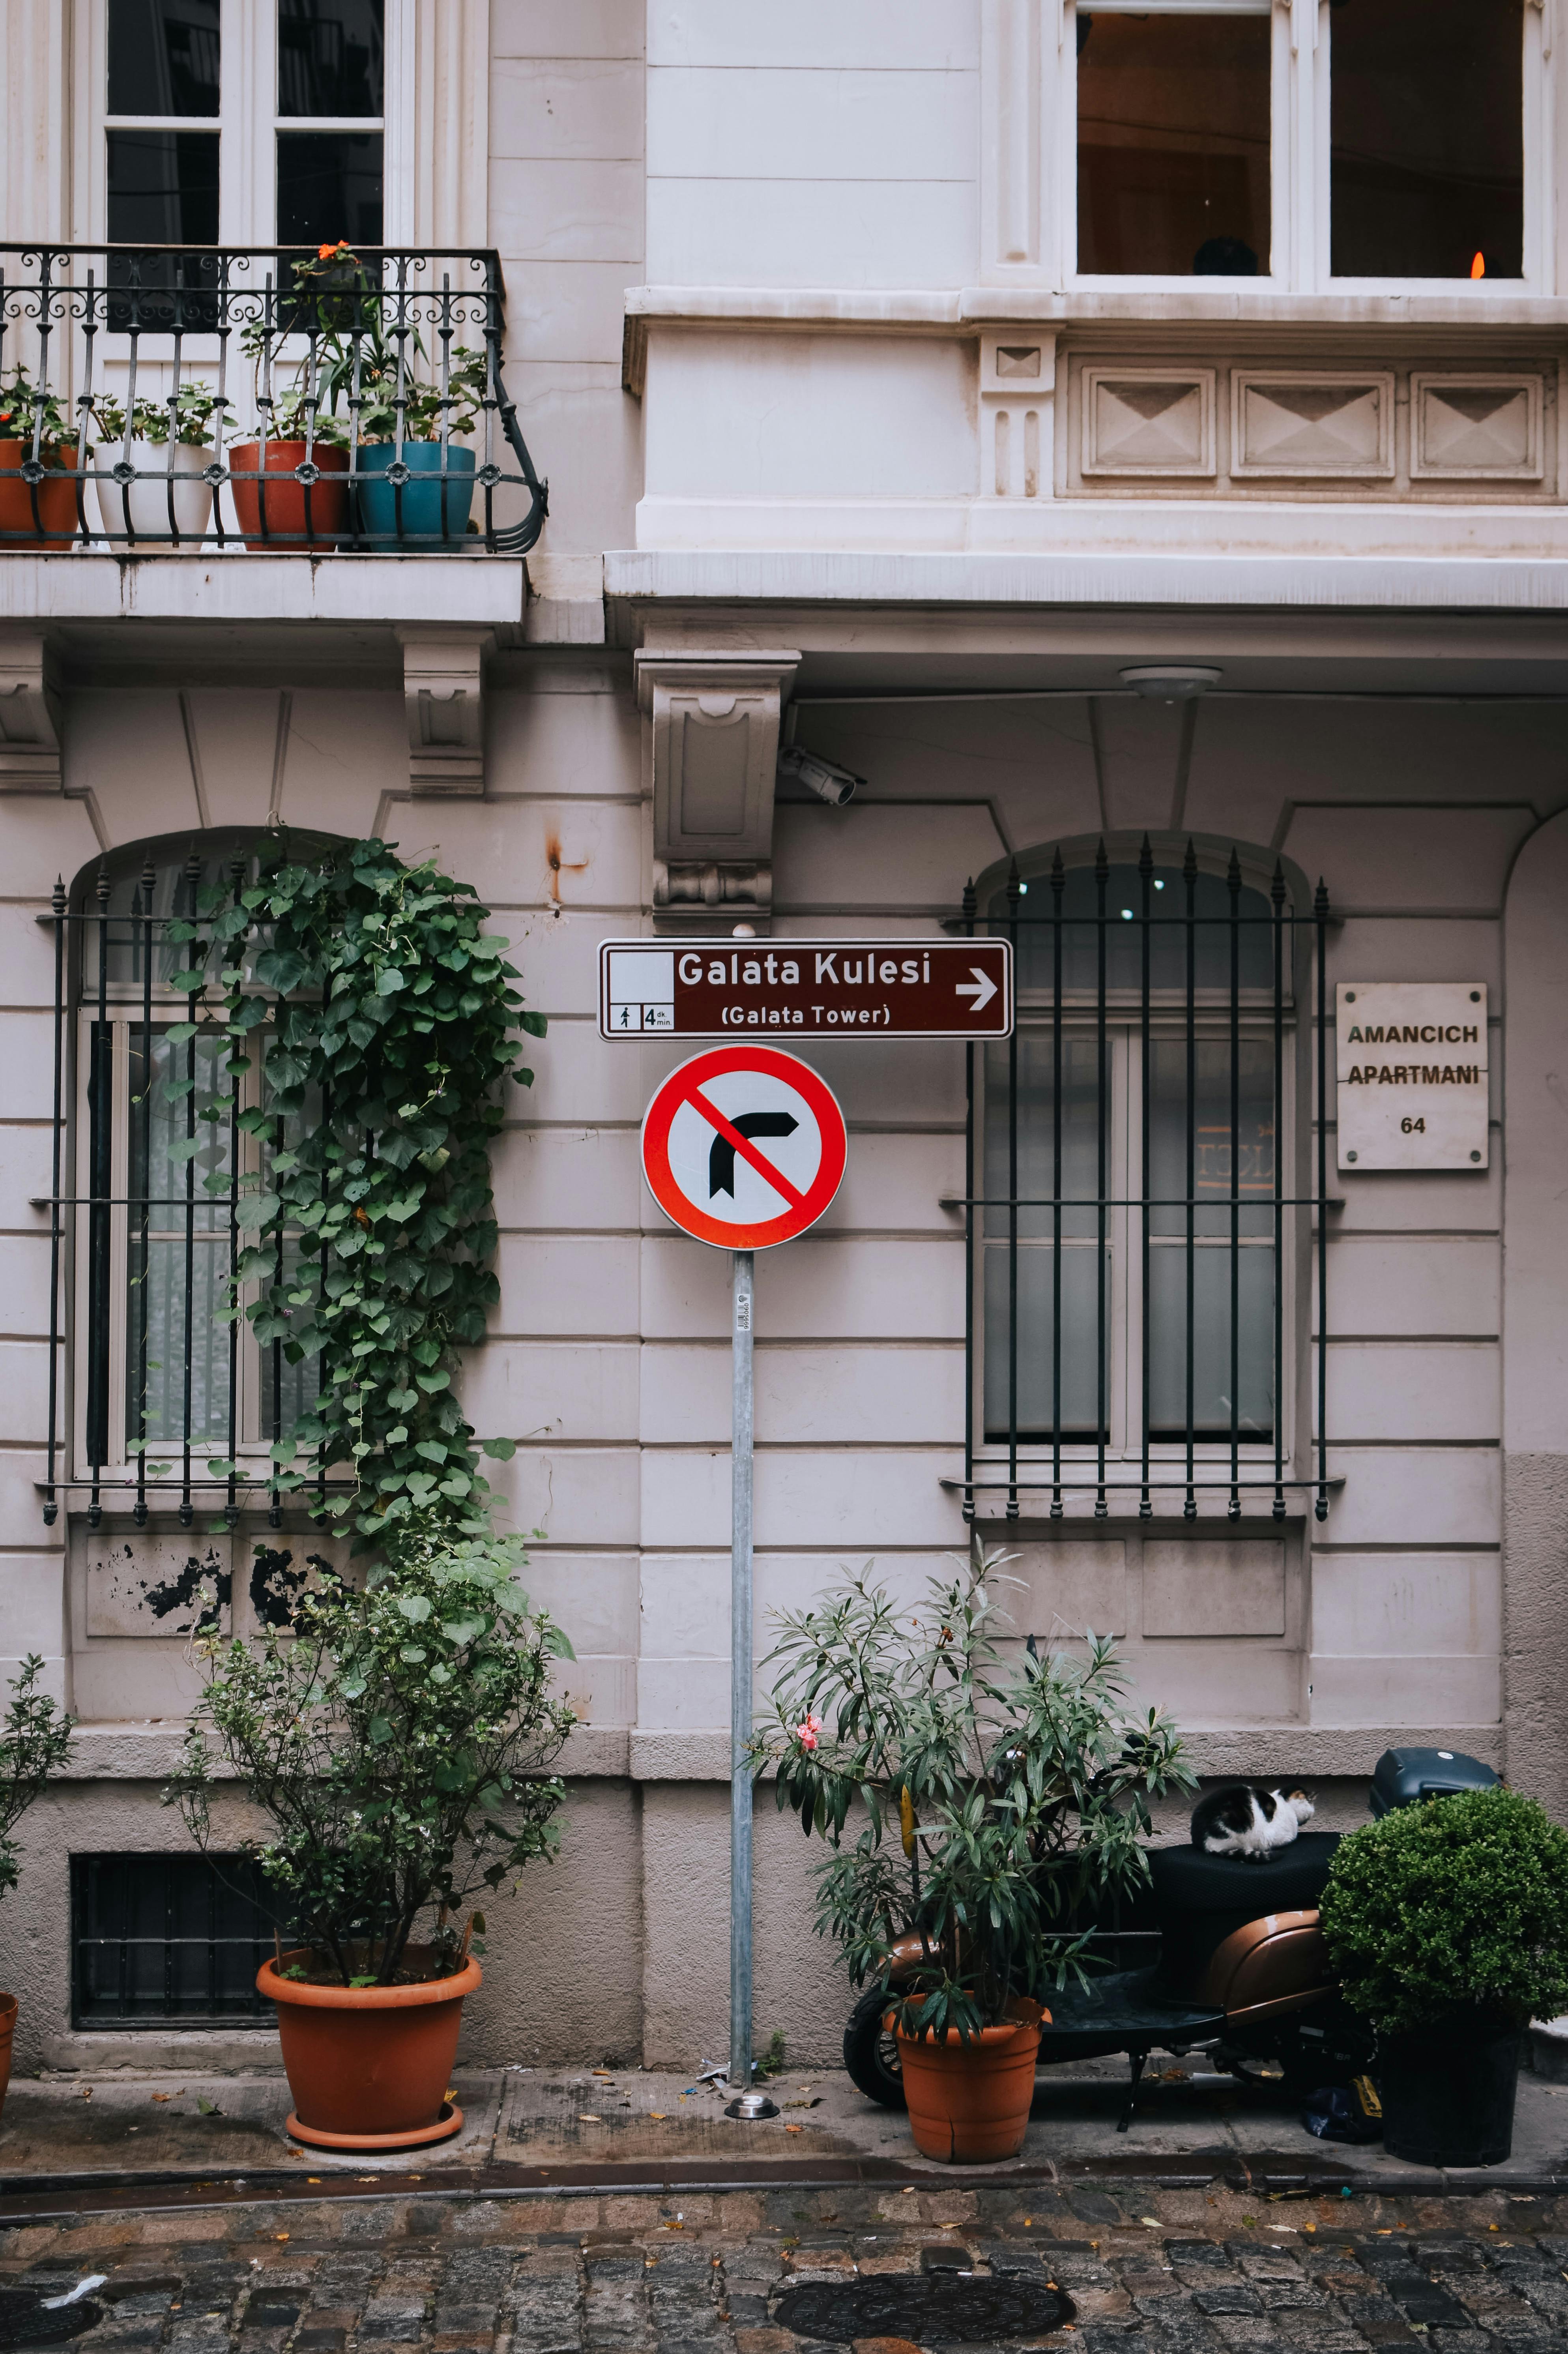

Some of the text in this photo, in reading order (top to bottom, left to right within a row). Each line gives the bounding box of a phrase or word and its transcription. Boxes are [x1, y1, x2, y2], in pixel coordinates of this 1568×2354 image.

[678, 952, 930, 985] Galata Kulesi
[645, 1009, 656, 1025] 4
[722, 1004, 890, 1025] (Galata Tower)
[1348, 1026, 1478, 1043] AMANCICH
[1348, 1066, 1479, 1084] APARTMANI
[1401, 1117, 1426, 1134] 64
